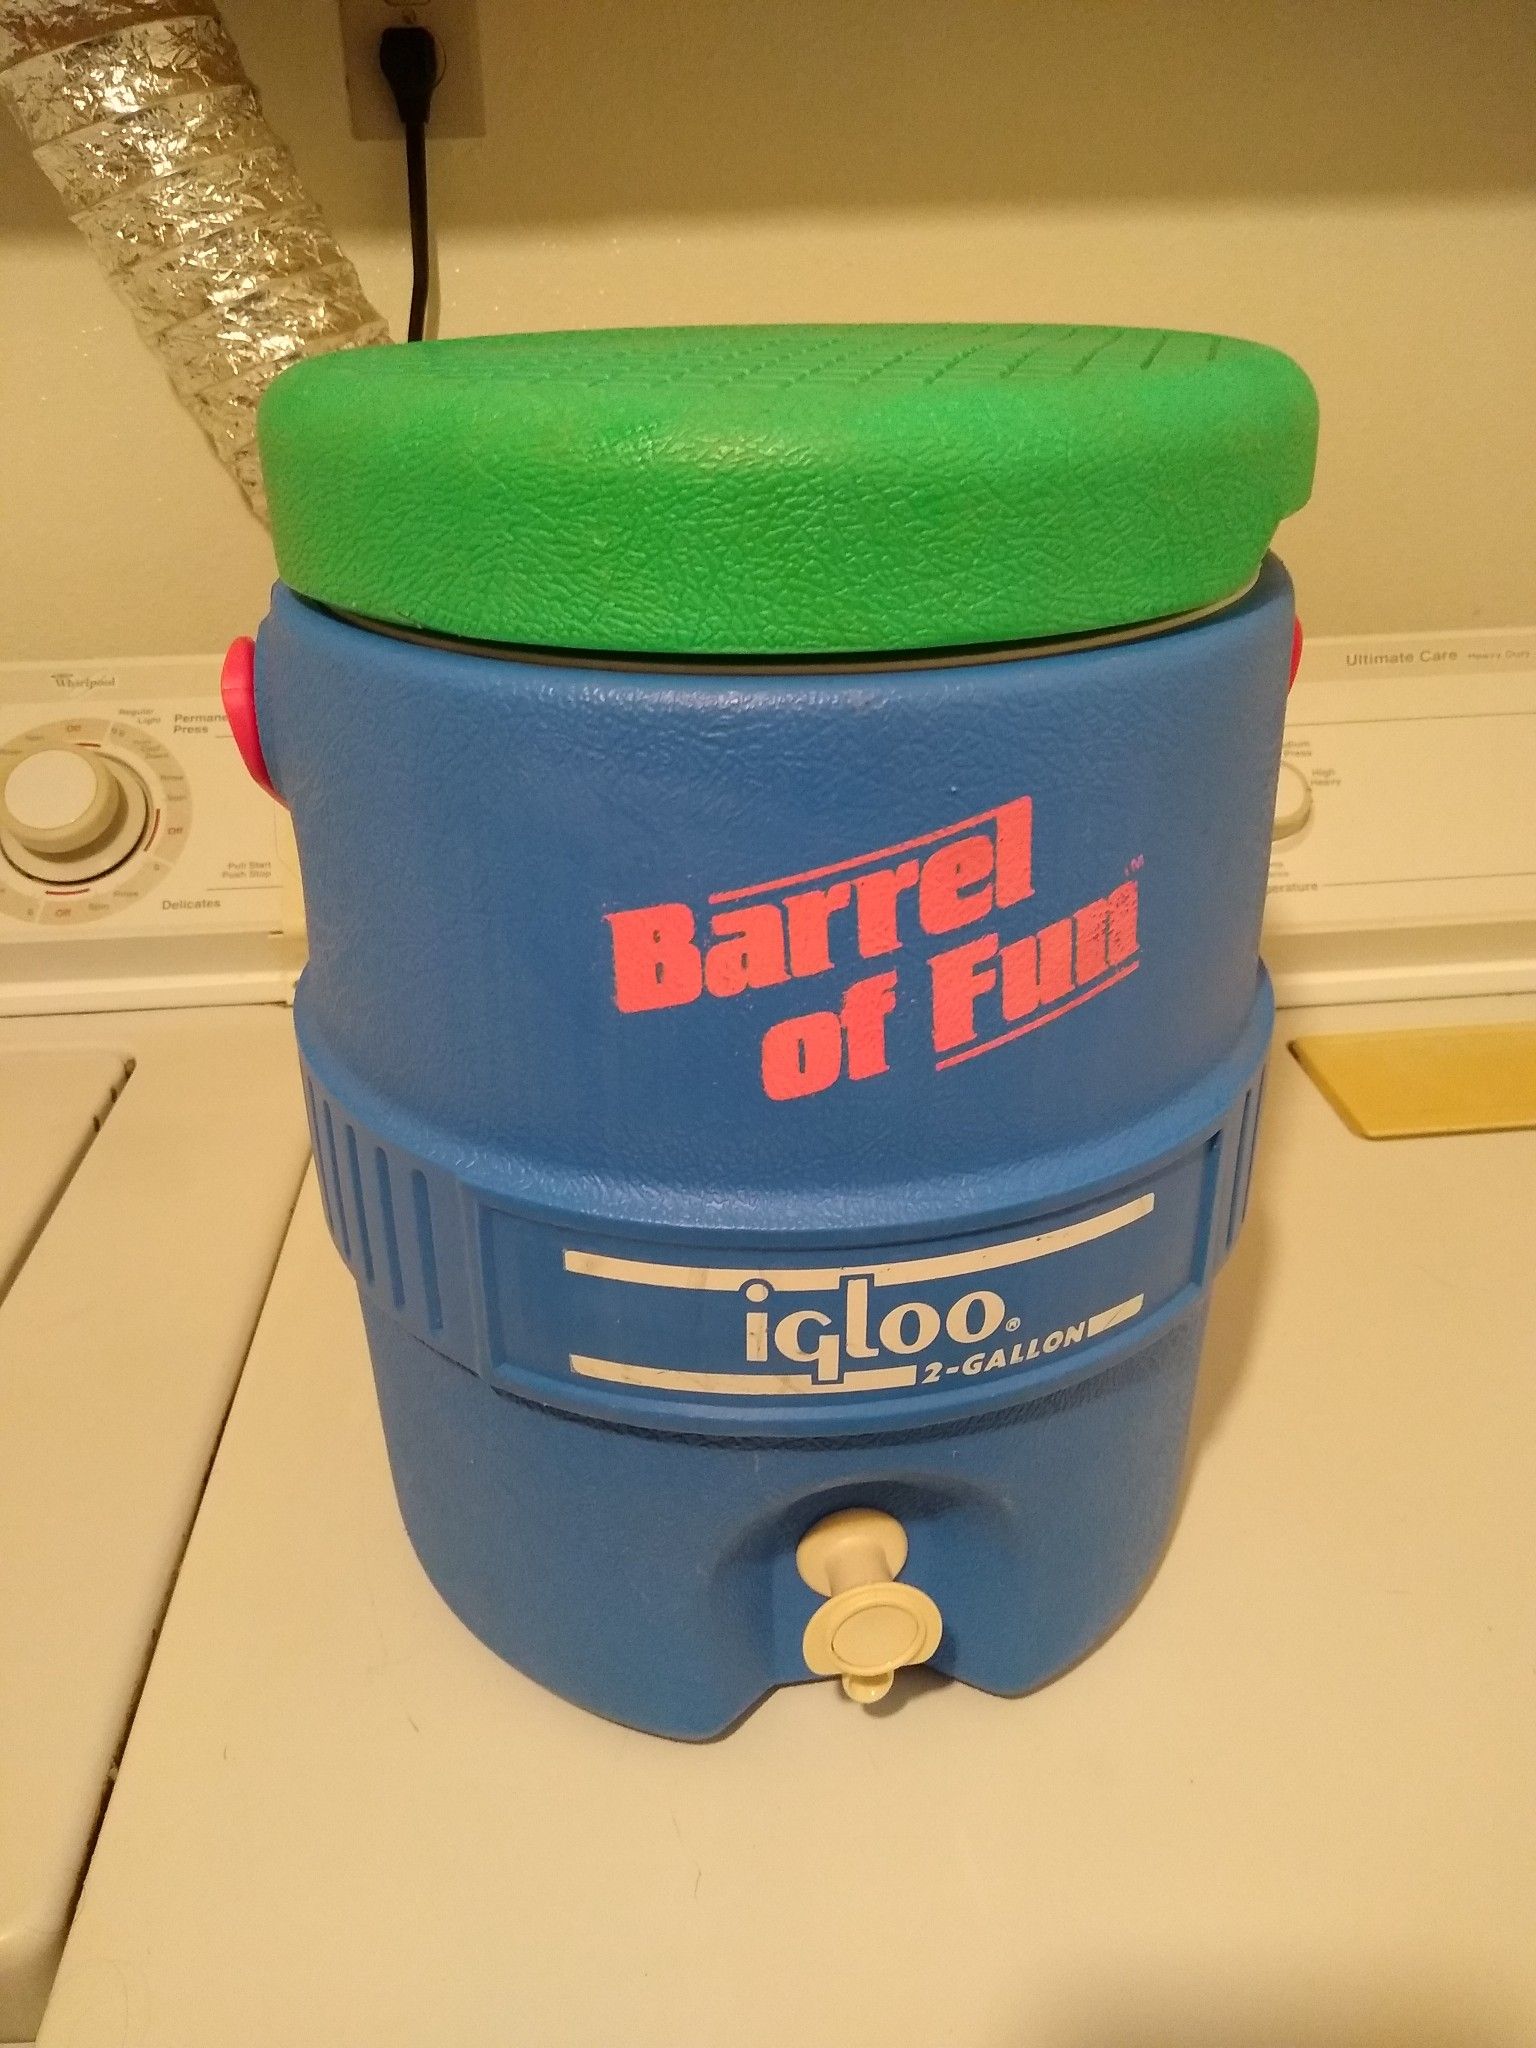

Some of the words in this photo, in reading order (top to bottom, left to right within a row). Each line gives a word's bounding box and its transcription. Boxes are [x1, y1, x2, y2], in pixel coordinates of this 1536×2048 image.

[1346, 652, 1414, 667] Ultimate
[1420, 650, 1458, 662] Care
[173, 725, 209, 734] Press
[162, 899, 222, 911] Delicates
[604, 796, 1035, 1013] Barrel
[762, 970, 898, 1101] of
[928, 879, 1140, 1053] Fun
[746, 1278, 1005, 1382] igloo
[921, 1319, 1092, 1385] 2-GALLON
